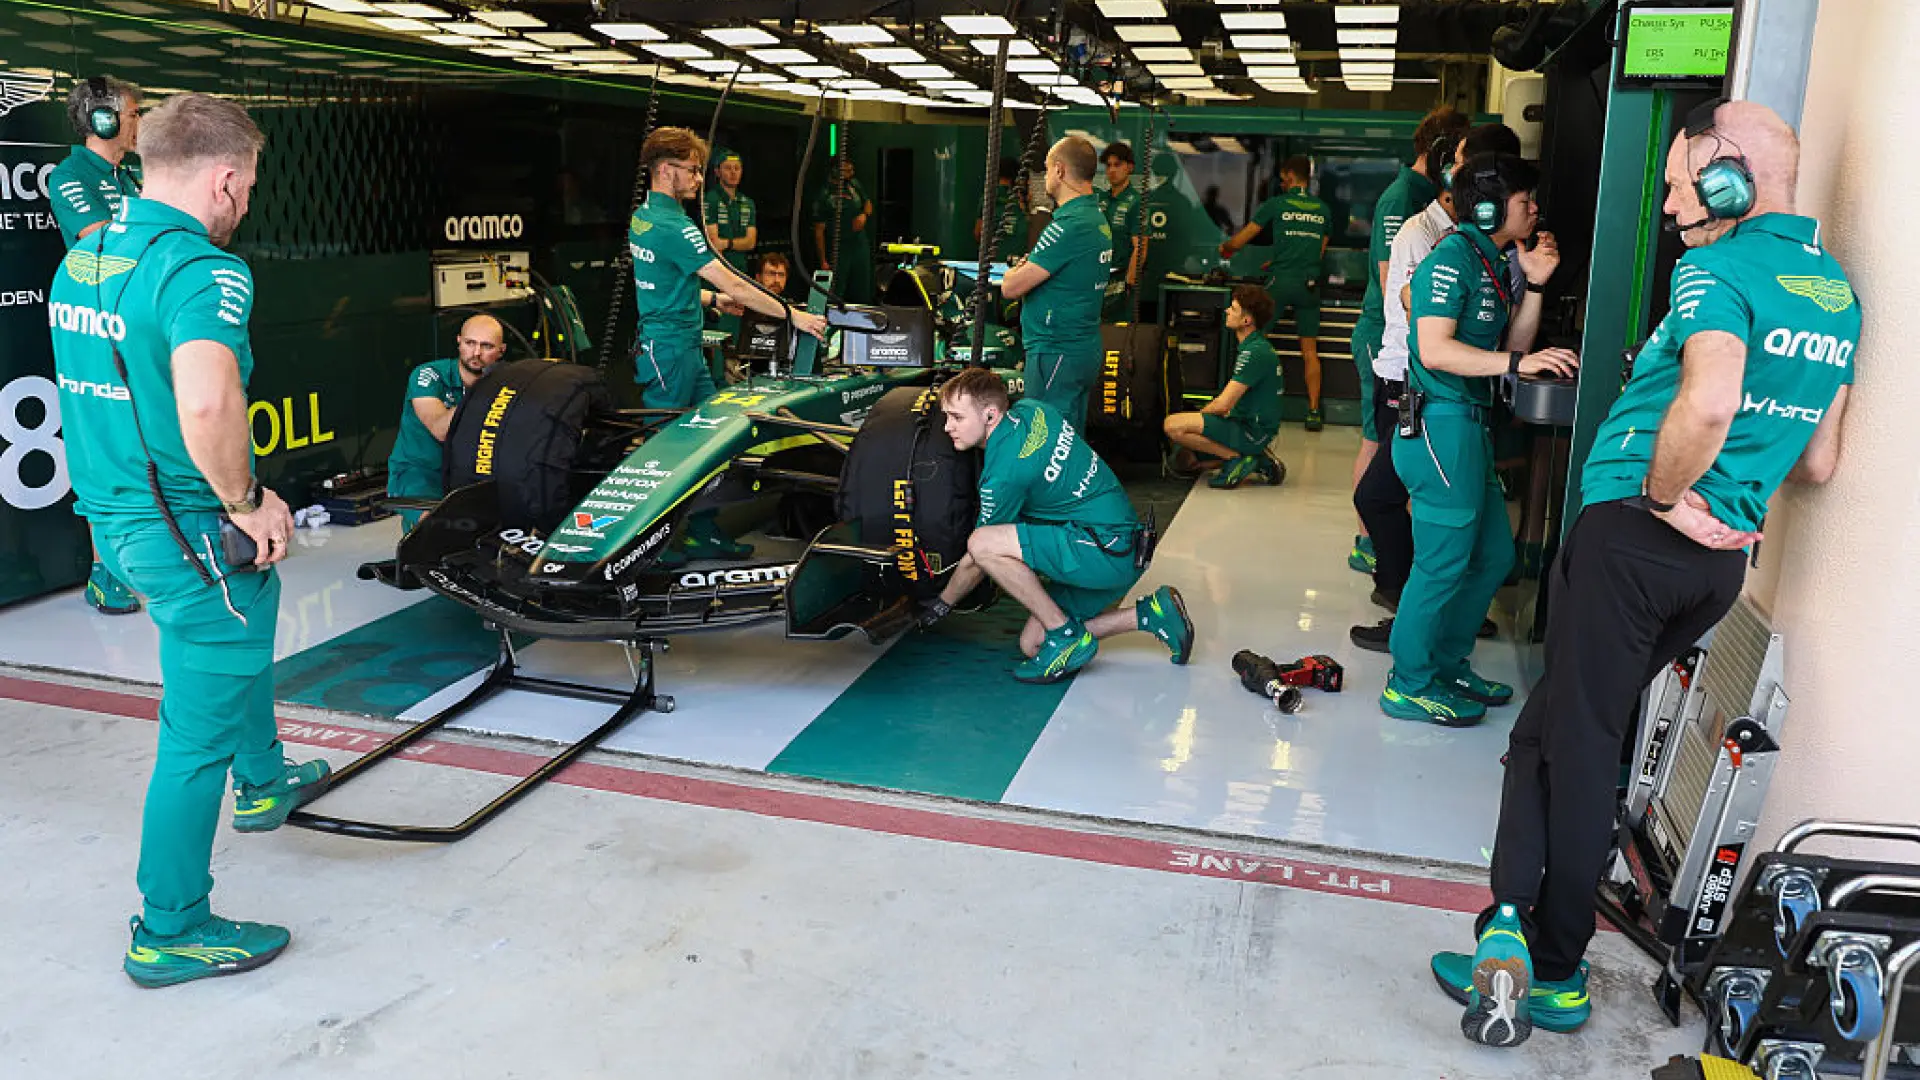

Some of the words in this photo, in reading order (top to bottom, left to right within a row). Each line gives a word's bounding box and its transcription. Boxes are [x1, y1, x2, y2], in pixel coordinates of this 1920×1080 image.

[1645, 49, 1664, 57] ERS
[23, 212, 60, 230] TEA
[444, 213, 524, 241] aramco
[1281, 211, 1325, 224] aramco
[1104, 350, 1120, 377] LEFT
[483, 386, 516, 427] FRONT
[1103, 381, 1117, 413] REAR
[249, 391, 335, 457] OLL
[475, 429, 496, 475] RIGHT
[1168, 850, 1391, 893] PIT-LANE
[1713, 867, 1734, 903] STEP
[1699, 873, 1718, 915] JUMBO
